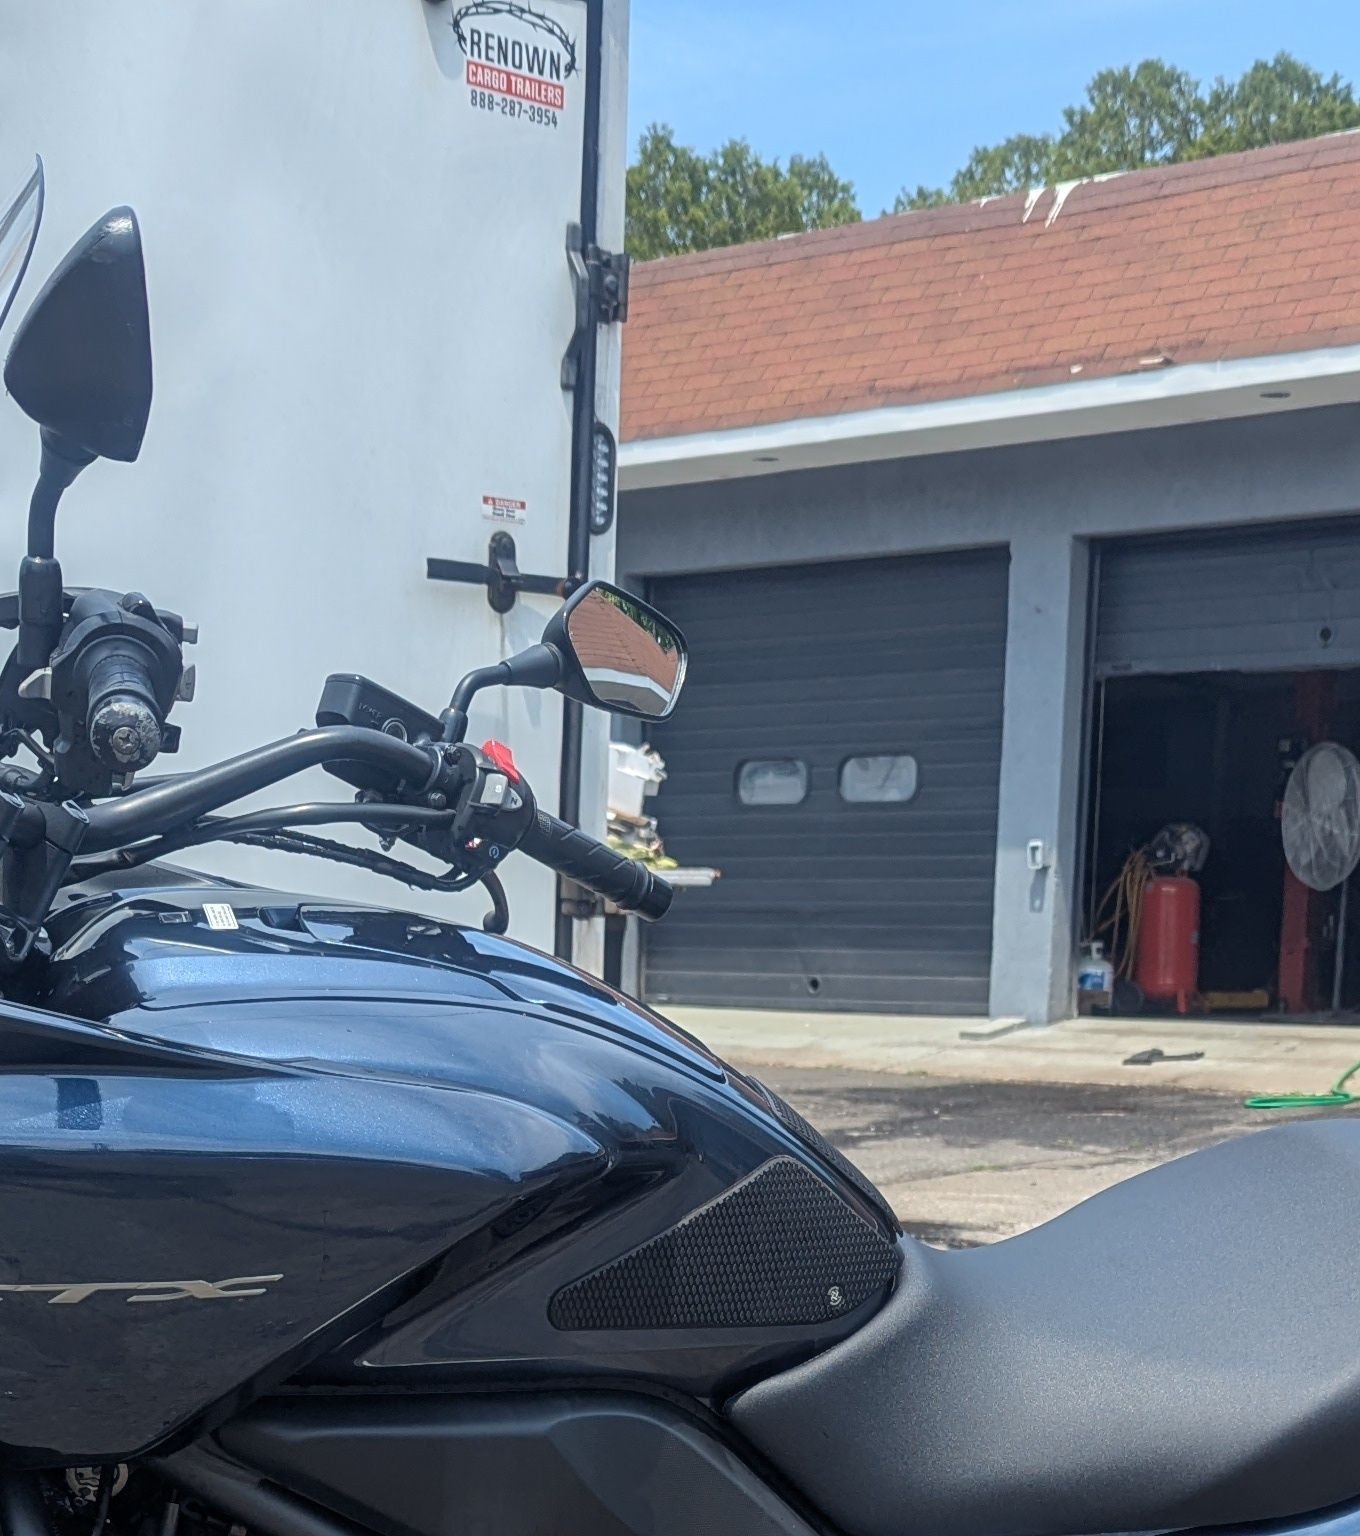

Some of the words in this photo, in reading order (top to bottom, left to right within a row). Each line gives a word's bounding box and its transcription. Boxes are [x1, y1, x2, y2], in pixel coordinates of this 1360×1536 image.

[469, 27, 562, 82] RENOWN
[468, 64, 507, 92] CARGO
[510, 76, 562, 107] TRAILERS
[470, 89, 558, 129] 888-287-3954
